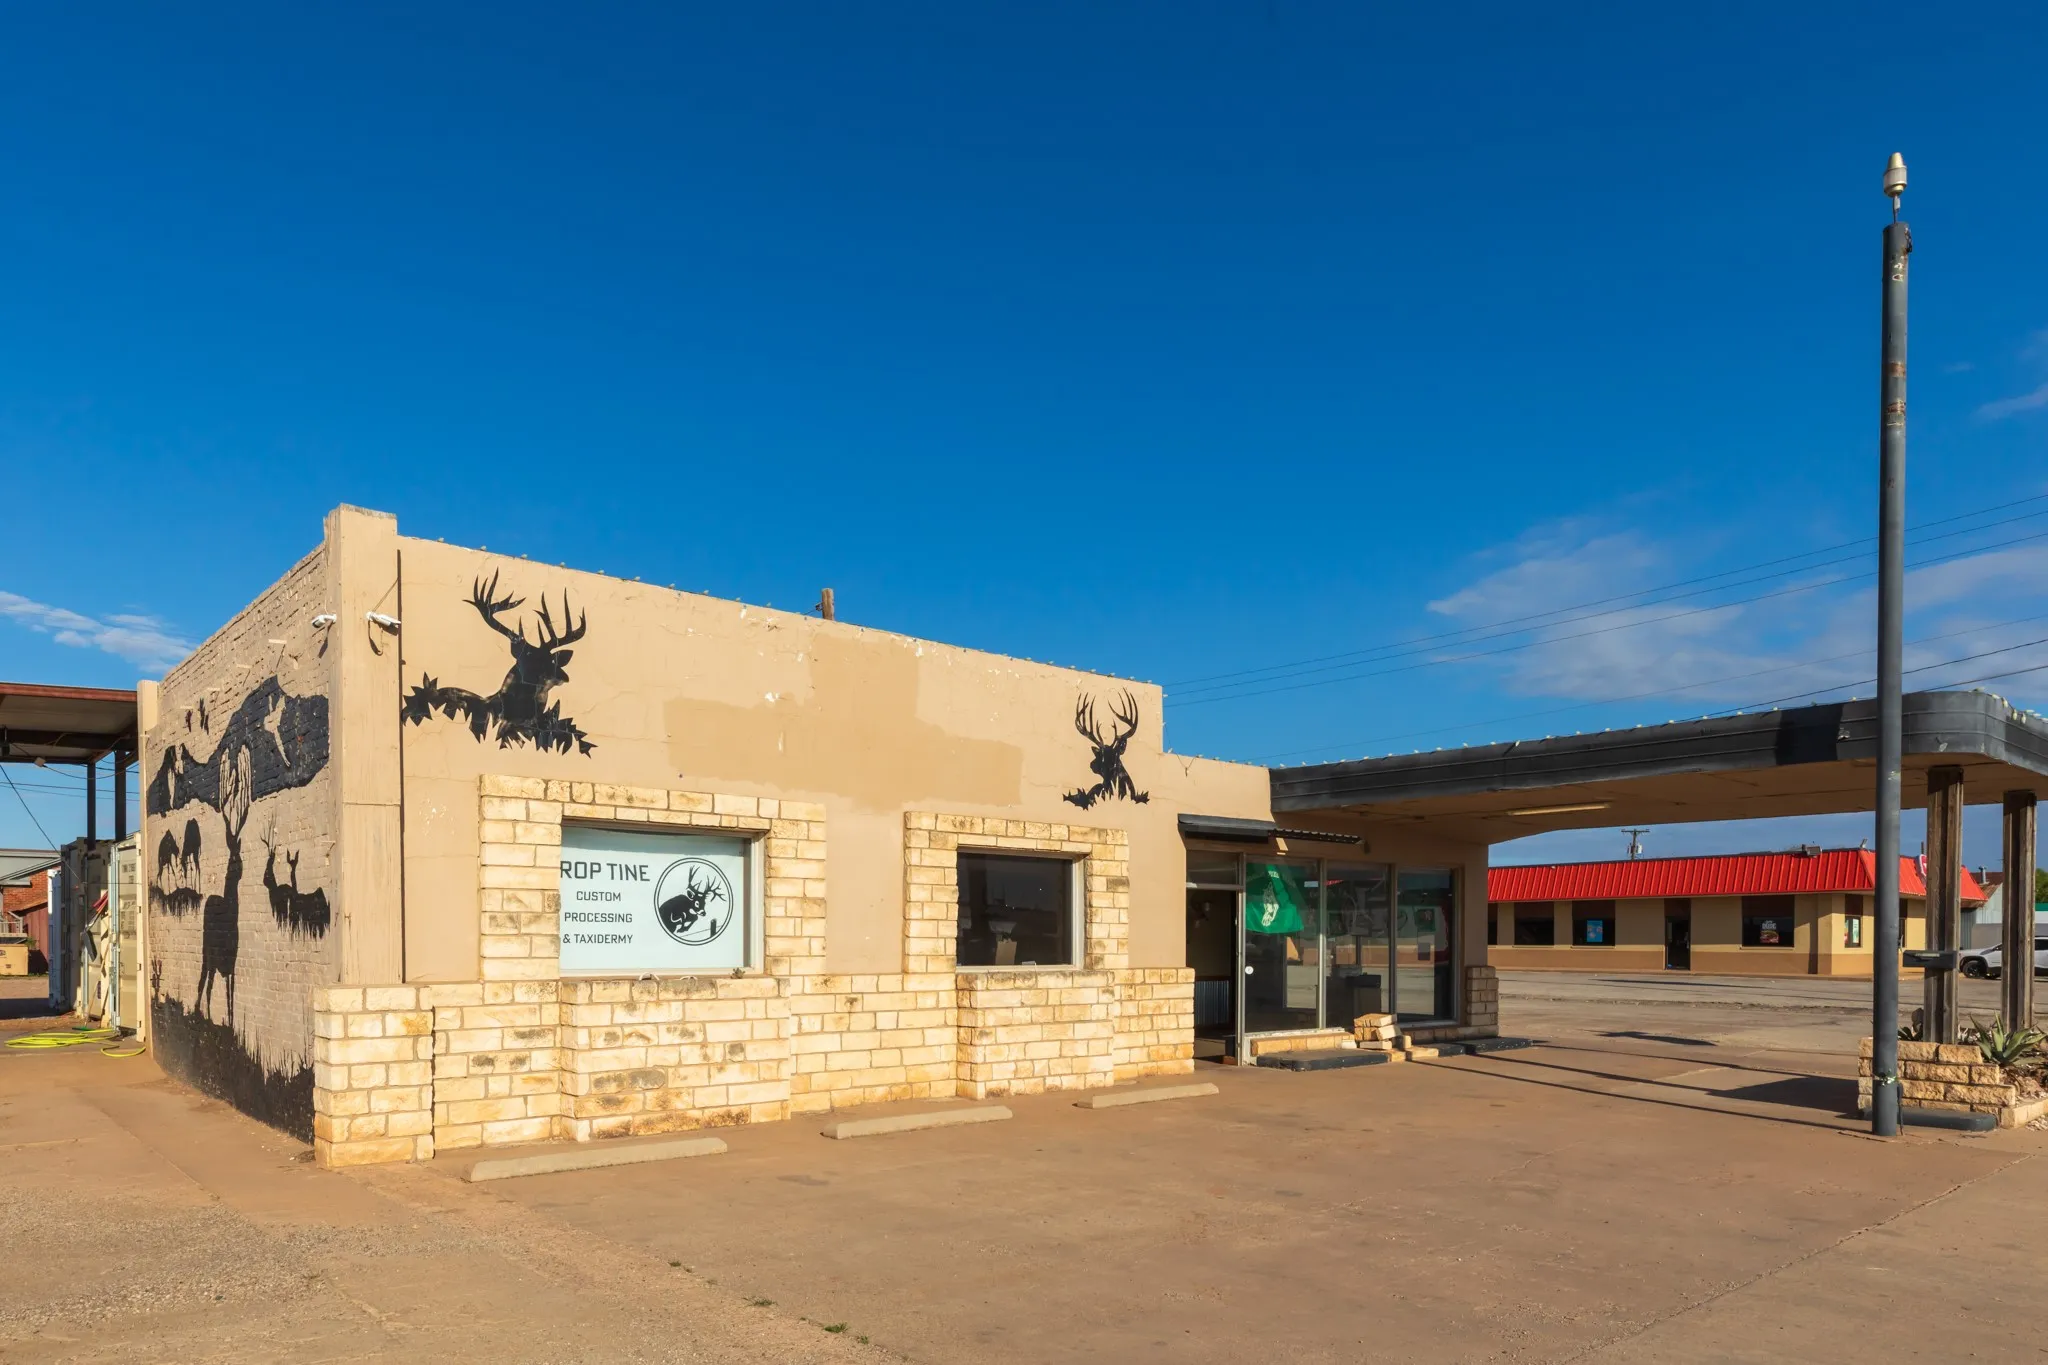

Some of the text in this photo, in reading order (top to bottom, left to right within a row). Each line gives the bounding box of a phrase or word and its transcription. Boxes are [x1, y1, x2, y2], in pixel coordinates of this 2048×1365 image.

[560, 860, 651, 882] ROP TINE
[576, 890, 622, 902] CUSTOM
[564, 911, 633, 923] PROCESSING
[562, 933, 633, 944] & TAXIDERMY
